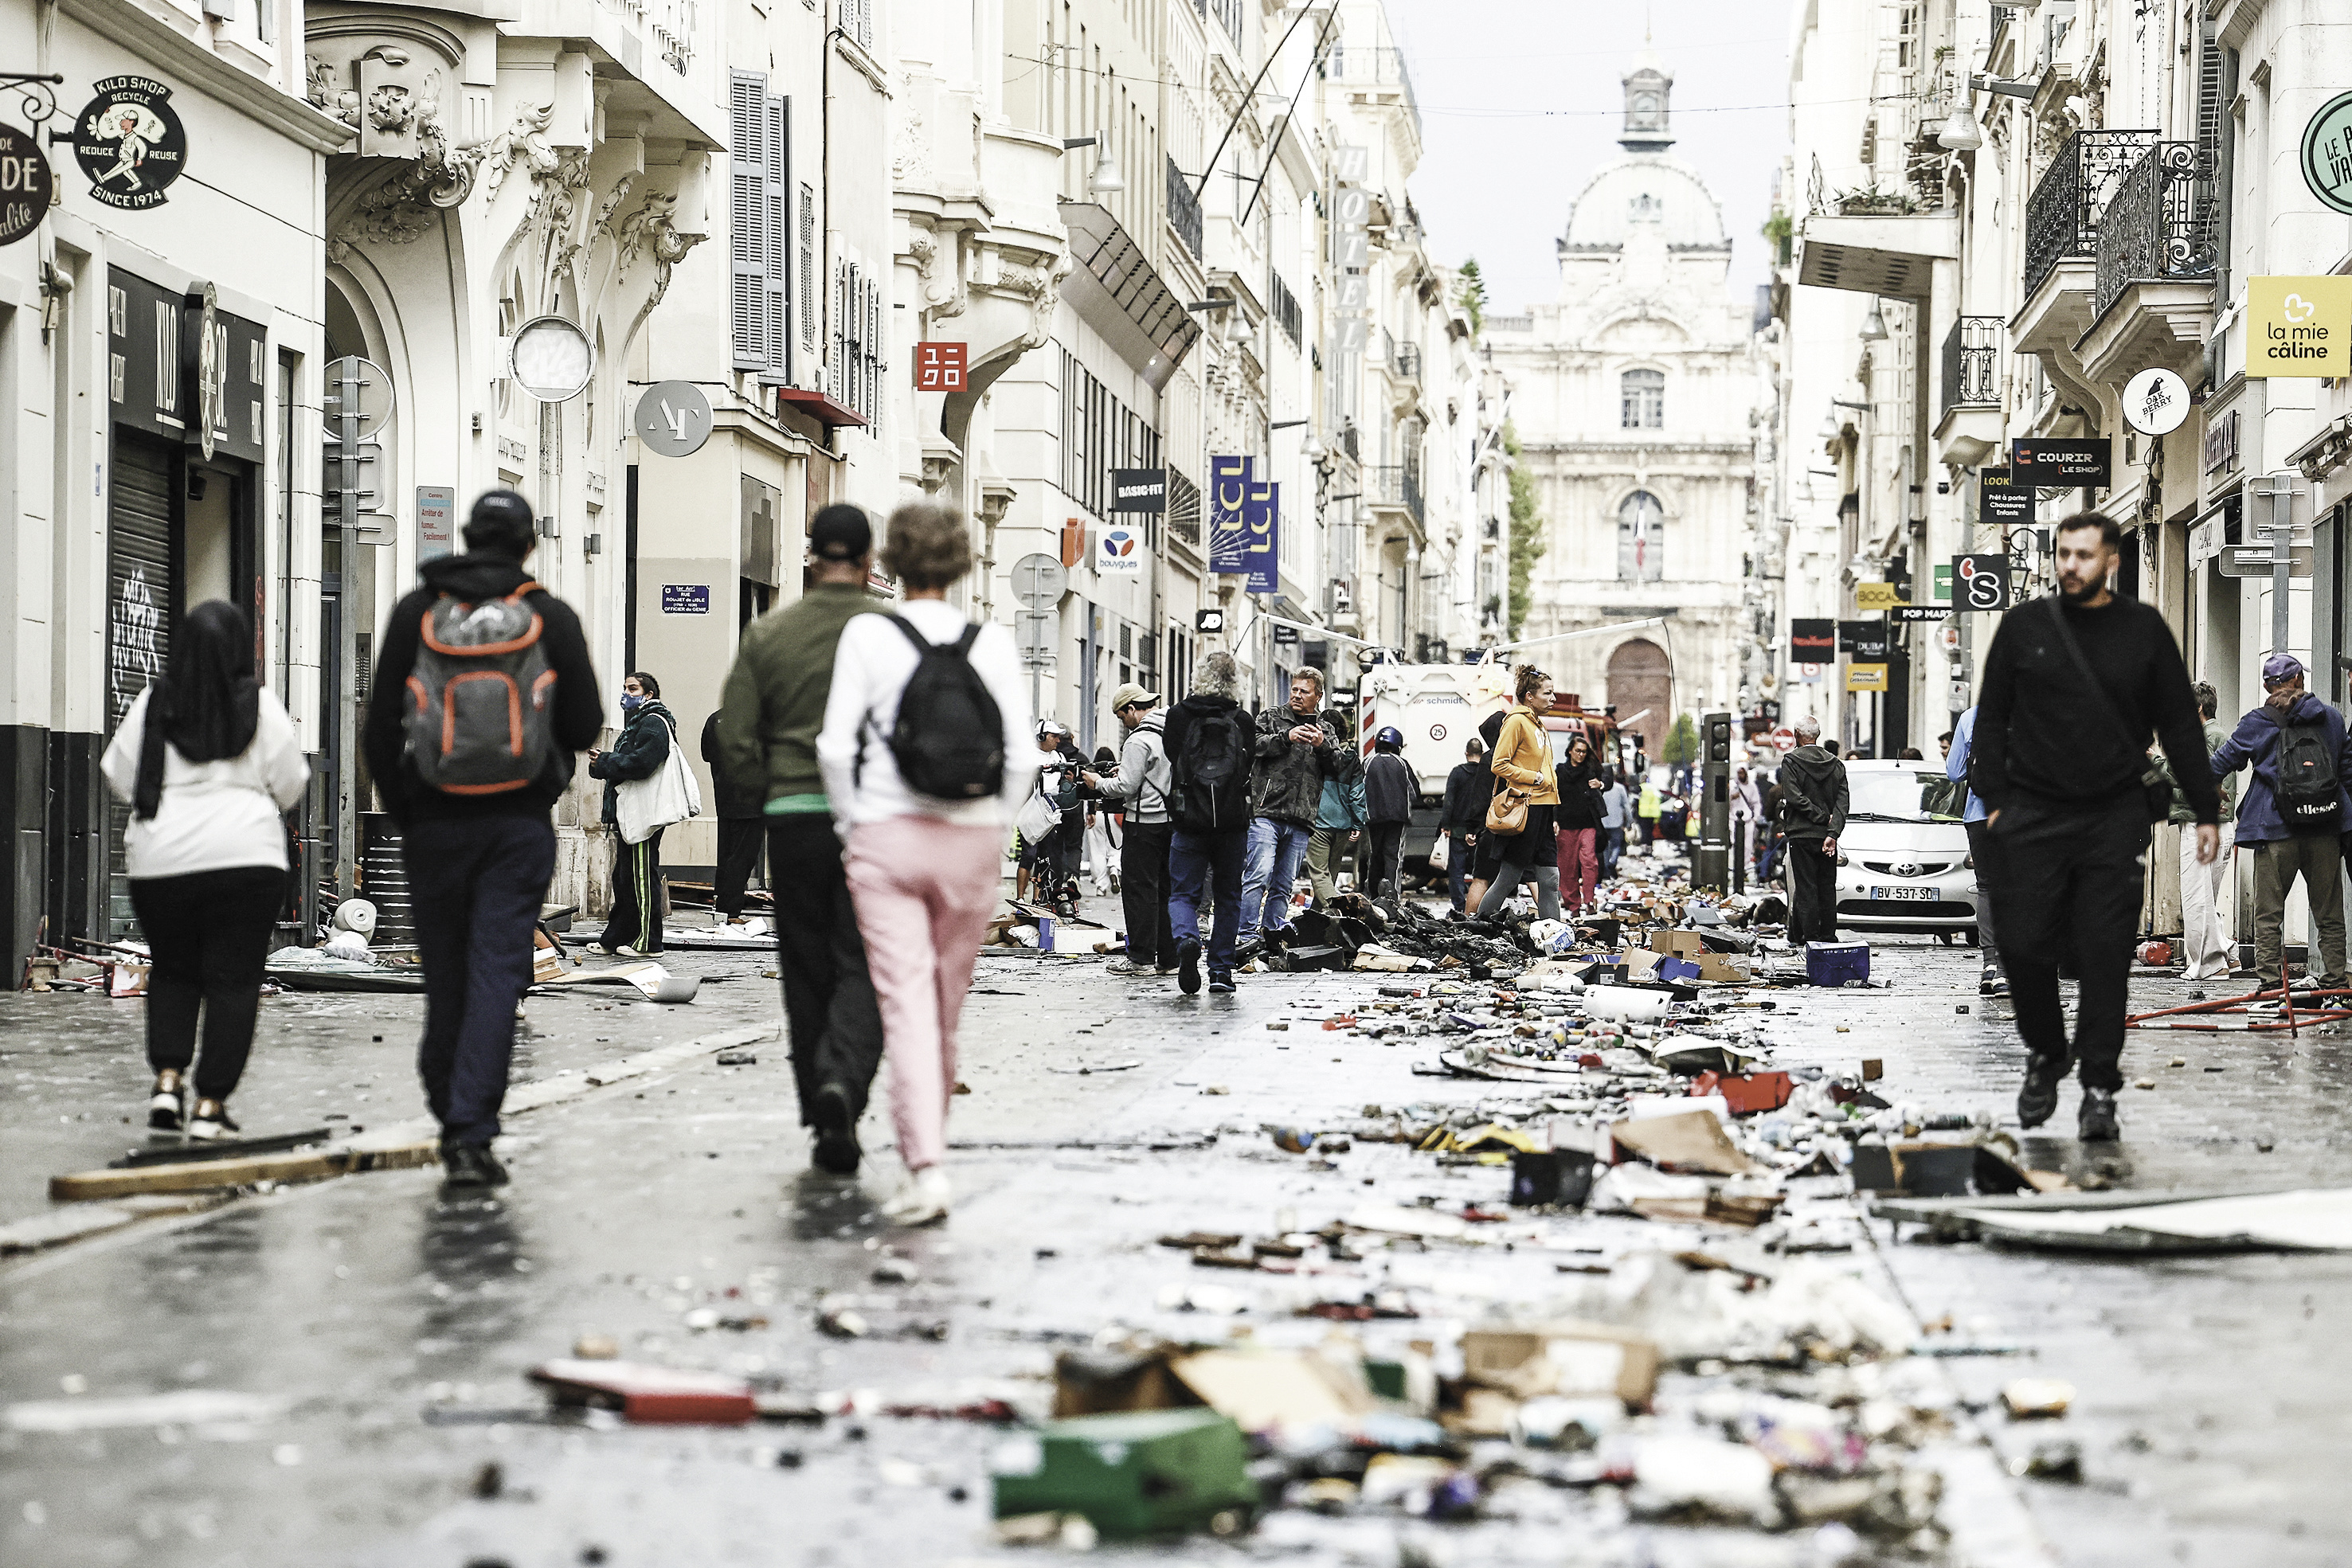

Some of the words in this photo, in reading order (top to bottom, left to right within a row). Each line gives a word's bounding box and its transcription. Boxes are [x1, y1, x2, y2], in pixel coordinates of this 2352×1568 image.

[96, 77, 127, 93] KILO
[130, 77, 166, 96] SHOP
[111, 92, 151, 105] RECYCLE
[80, 146, 114, 156] REDUCE
[149, 150, 178, 161] REUSE
[2324, 137, 2341, 162] LE
[92, 186, 130, 207] SINCE
[133, 190, 162, 207] 1974
[1340, 147, 1365, 350] HOTEL
[2268, 322, 2286, 340] la
[2292, 323, 2328, 340] mie
[2268, 342, 2328, 359] câline
[2142, 395, 2172, 416] BERRY
[2146, 391, 2165, 405] OAK
[2037, 452, 2092, 463] COURIR
[1984, 476, 2010, 486] LOOK
[1219, 456, 1244, 530] LCL
[1250, 481, 1271, 553] LCL
[1099, 558, 1137, 569] bouygues
[1902, 610, 1923, 619] POP
[2296, 801, 2338, 815] ellesse
